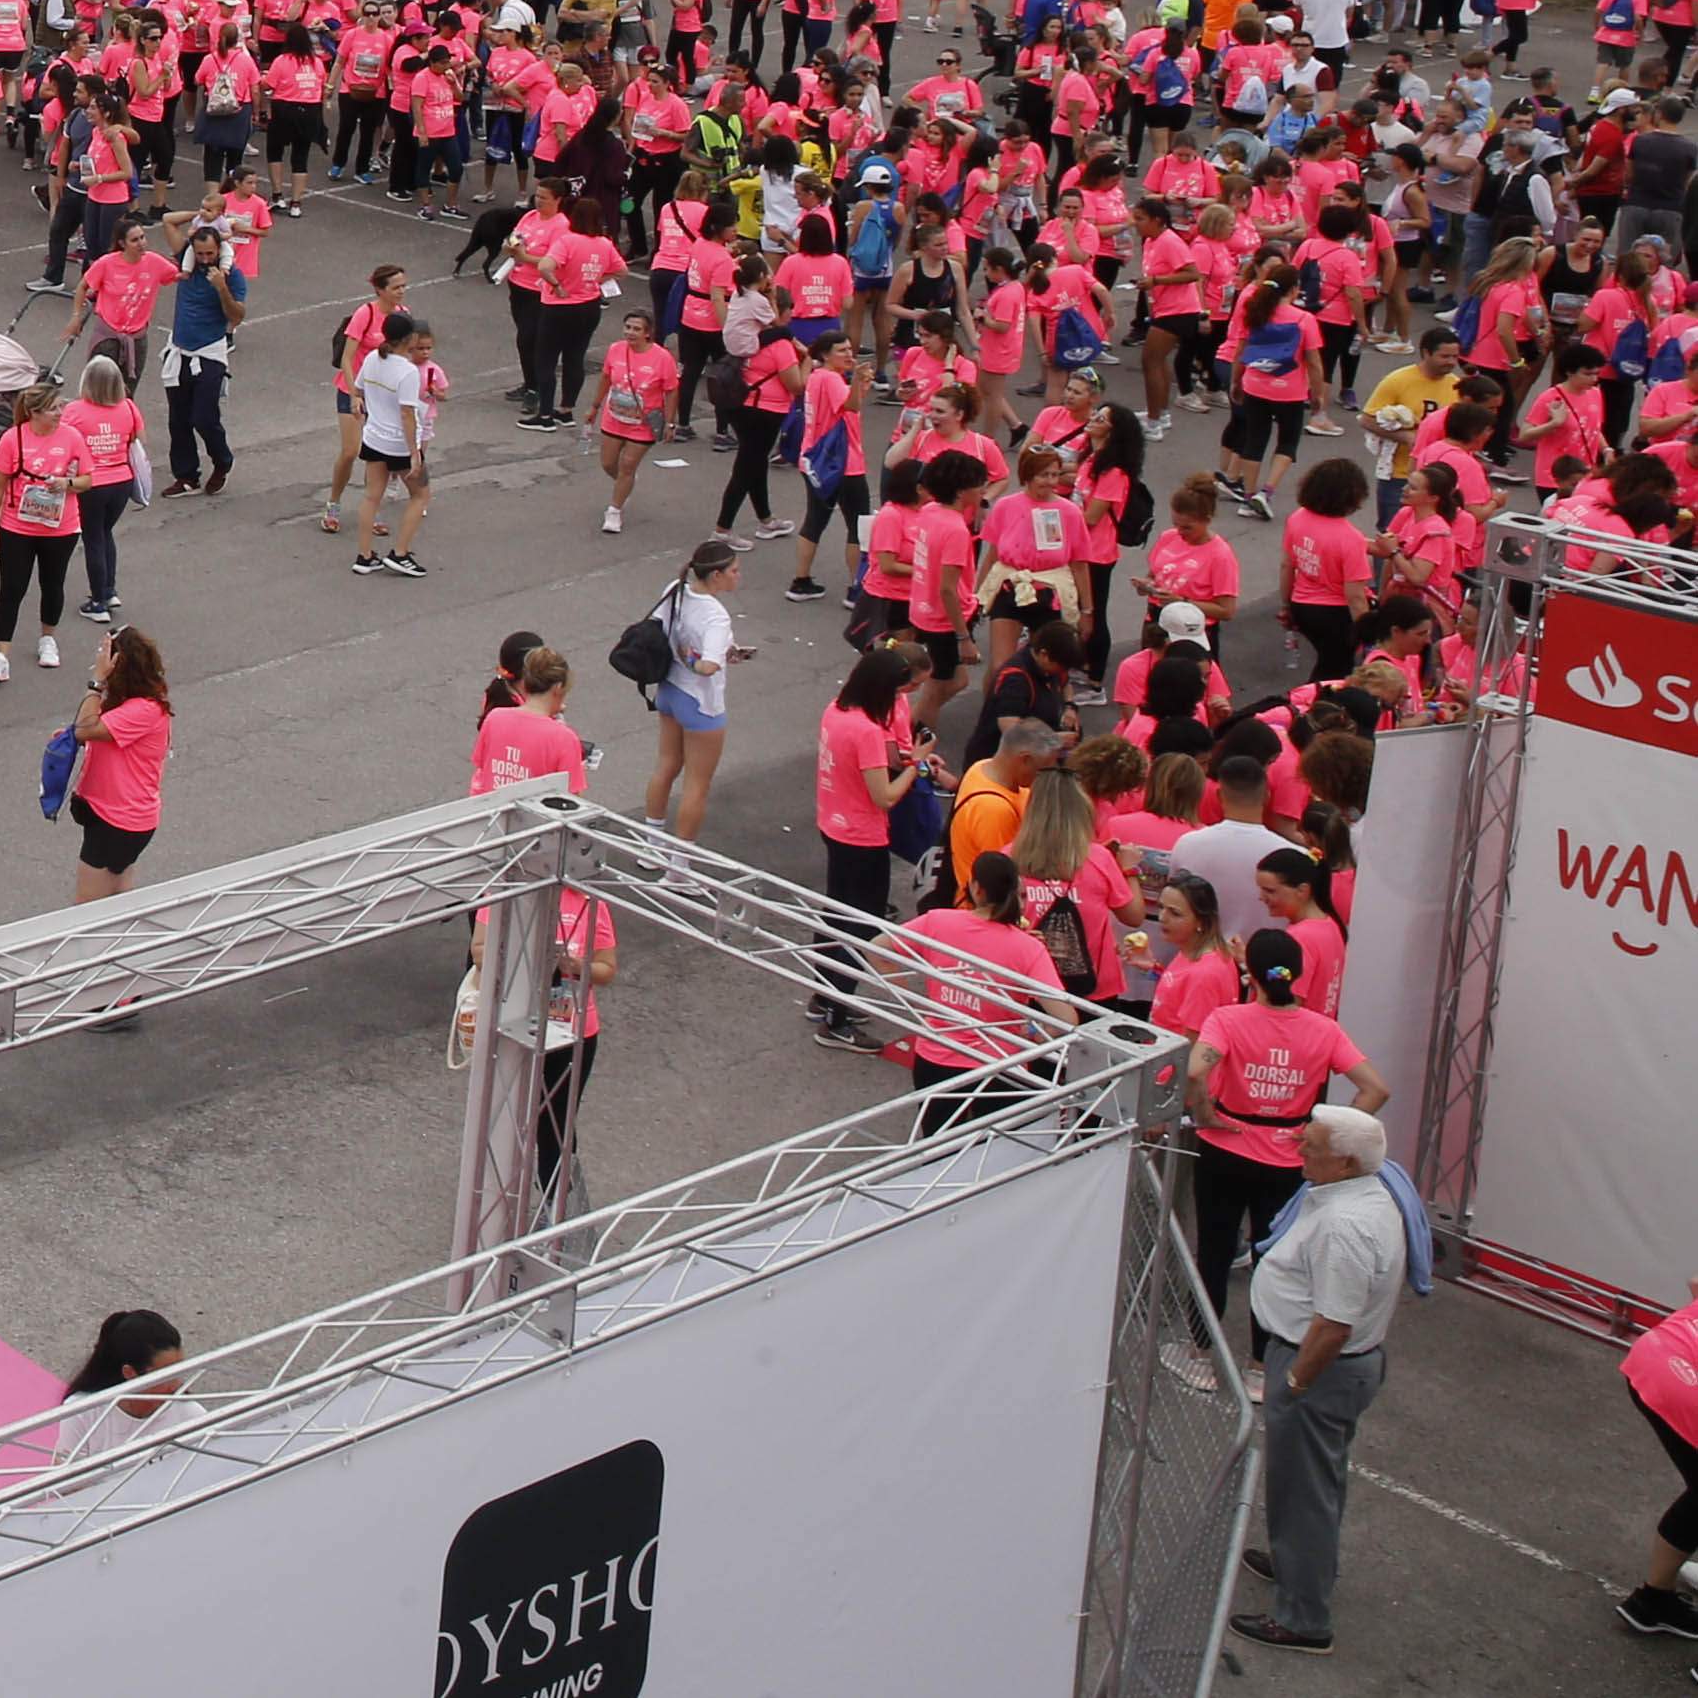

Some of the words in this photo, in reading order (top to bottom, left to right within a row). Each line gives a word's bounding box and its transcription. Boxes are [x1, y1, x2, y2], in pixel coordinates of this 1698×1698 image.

[99, 423, 111, 434] TU
[1653, 674, 1698, 724] S
[506, 746, 522, 762] TU
[940, 986, 982, 1012] SUMA
[1269, 1048, 1290, 1066] TU
[1244, 1062, 1307, 1086] DORSAL
[1248, 1080, 1296, 1100] SUMA
